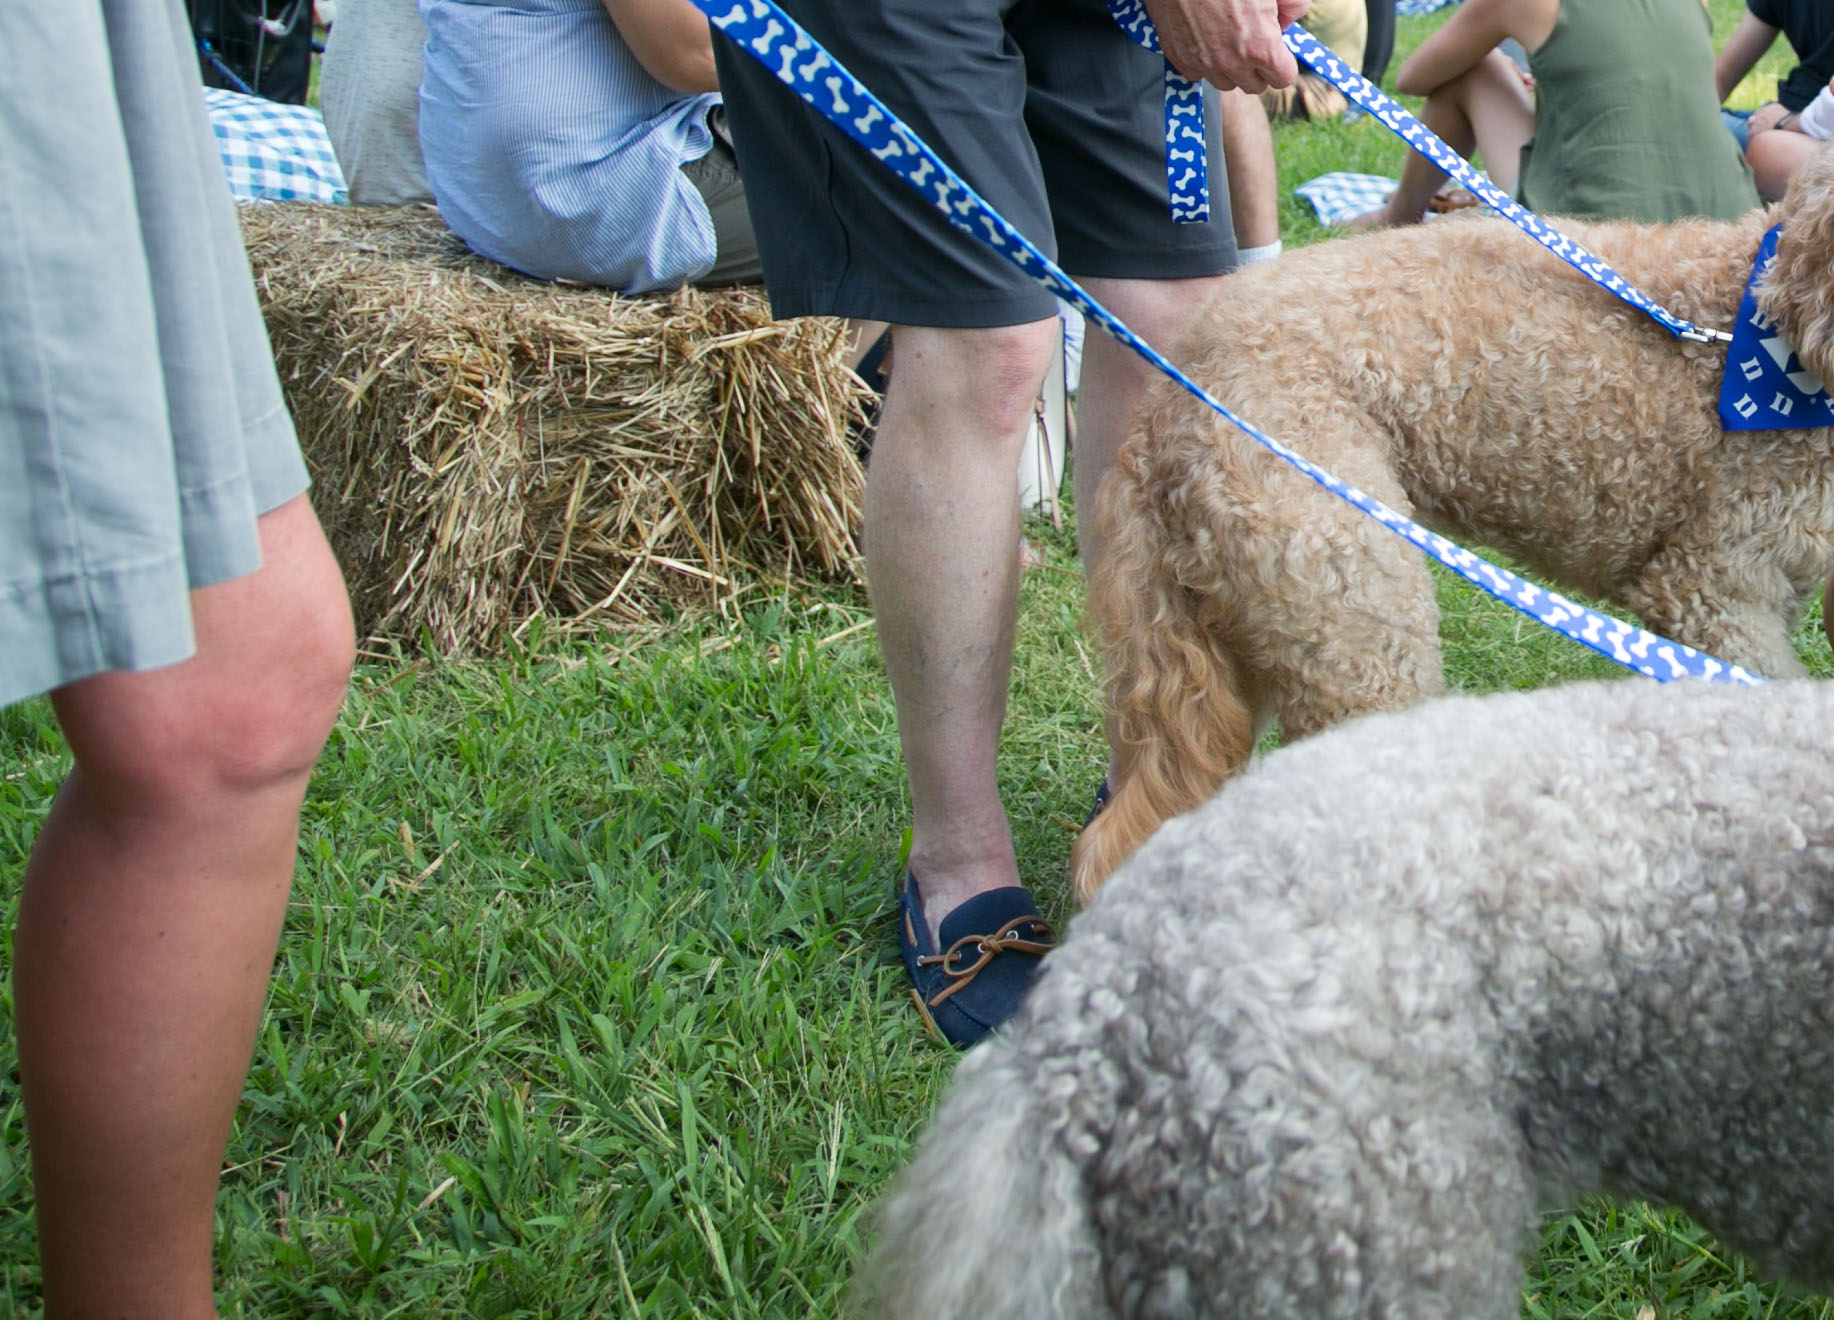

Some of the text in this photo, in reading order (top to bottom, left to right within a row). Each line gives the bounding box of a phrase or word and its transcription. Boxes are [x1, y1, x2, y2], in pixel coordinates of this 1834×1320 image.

[1740, 356, 1763, 381] D
[1733, 393, 1758, 419] D
[1769, 391, 1794, 417] D
